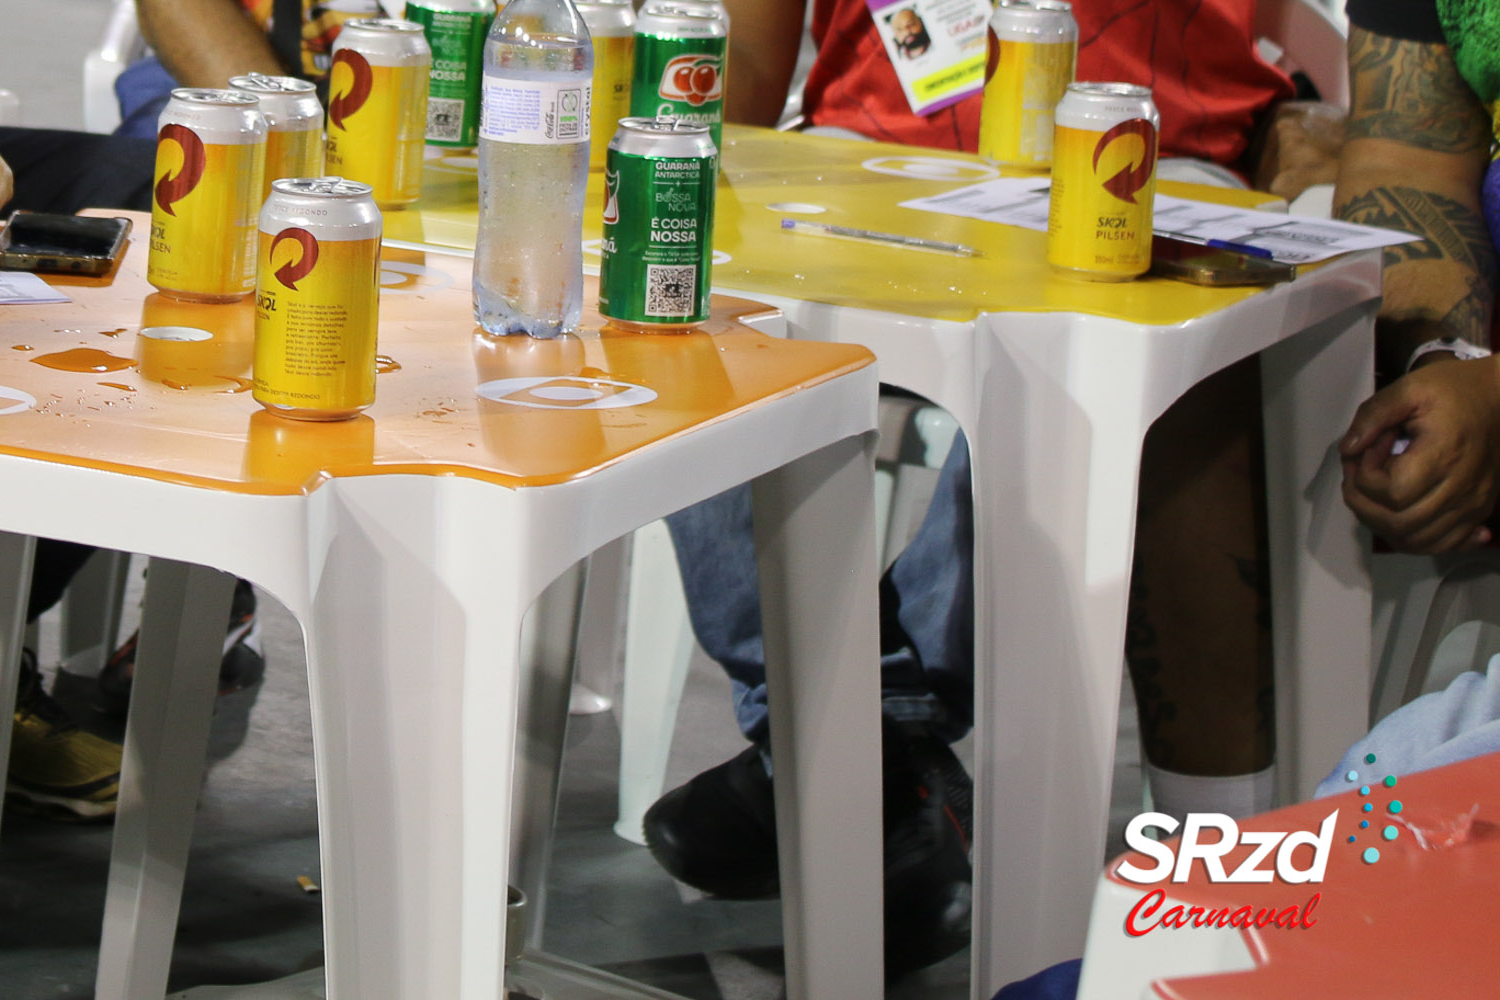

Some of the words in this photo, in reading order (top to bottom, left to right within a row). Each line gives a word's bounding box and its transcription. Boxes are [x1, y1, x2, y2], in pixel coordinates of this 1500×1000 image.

[655, 160, 701, 171] GUARANÁ
[654, 170, 700, 179] ANTARCTICA
[660, 217, 698, 230] COISA
[1096, 216, 1127, 229] SKOL
[649, 230, 697, 243] NOSSA
[1095, 230, 1136, 241] PILSEN
